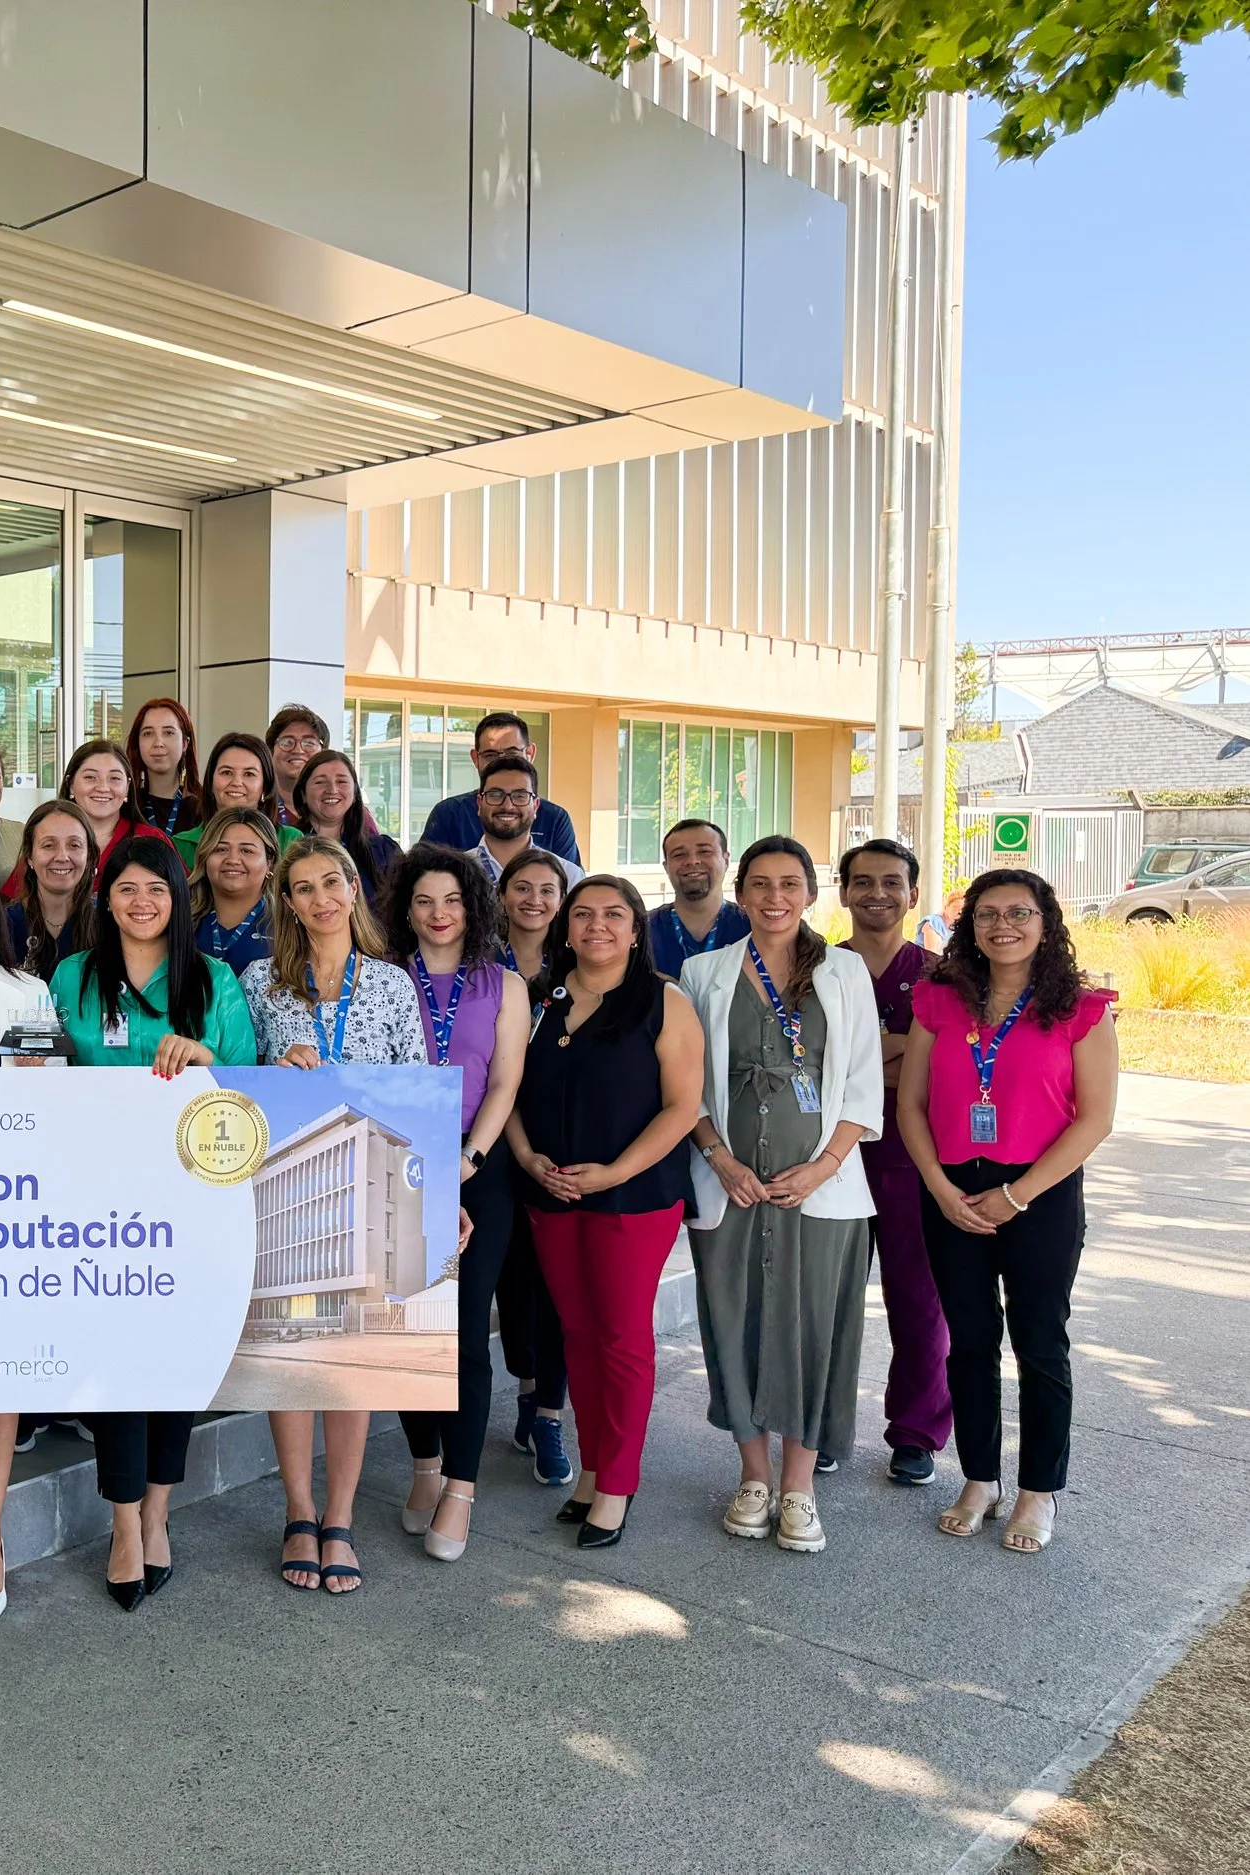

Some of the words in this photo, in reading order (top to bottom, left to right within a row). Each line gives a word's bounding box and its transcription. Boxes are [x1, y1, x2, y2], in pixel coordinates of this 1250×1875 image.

[193, 1092, 215, 1107] MERCO
[216, 1091, 237, 1099] SALUD
[214, 1119, 230, 1141] 1
[198, 1143, 211, 1152] EN
[213, 1141, 246, 1152] ÑUBLE
[18, 1265, 62, 1298] de
[73, 1257, 175, 1296] Ñuble
